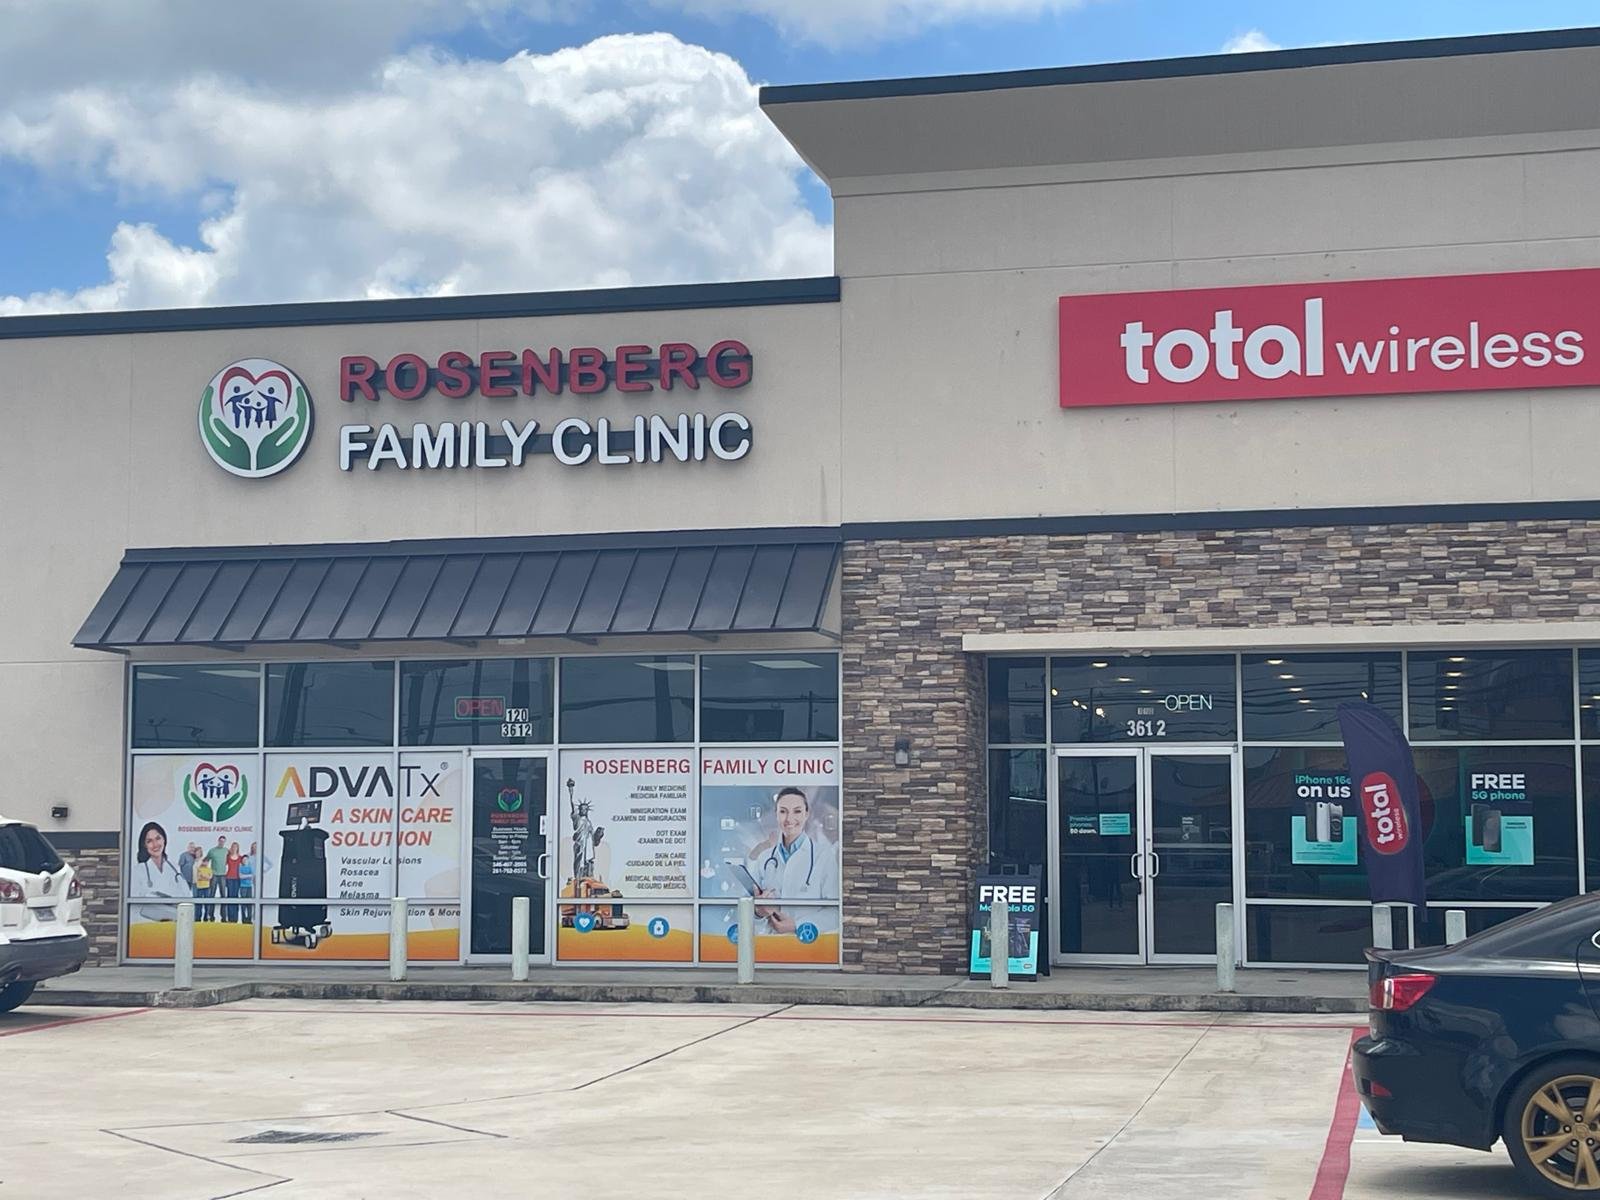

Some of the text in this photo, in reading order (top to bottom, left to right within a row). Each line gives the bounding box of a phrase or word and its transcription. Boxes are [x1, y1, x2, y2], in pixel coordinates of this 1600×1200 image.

[1120, 297, 1585, 384] total wireless
[340, 340, 752, 401] ROSENBERG
[340, 411, 752, 471] FAMILY CLINIC
[457, 699, 503, 717] OPEN
[1165, 694, 1213, 711] OPEN
[507, 709, 528, 721] 120
[502, 723, 532, 736] 3612
[1127, 720, 1166, 737] 3612
[584, 759, 834, 774] ROSENBERG FAMILY CLINIC
[1295, 775, 1333, 784] iPhone
[1471, 773, 1526, 790] FREE
[1297, 785, 1351, 798] on us
[1472, 791, 1525, 802] 5G phone
[331, 808, 454, 823] A SKIN CARE
[1364, 783, 1395, 844] total
[331, 831, 433, 846] SOLUTION
[341, 857, 379, 865] Vascular
[340, 868, 379, 876] Rosacea
[340, 880, 363, 888] Acne
[340, 891, 379, 899] Melasma
[980, 885, 1036, 903] FREE
[340, 908, 461, 917] Skin Rejuvtion & More
[1022, 904, 1035, 912] 5G
